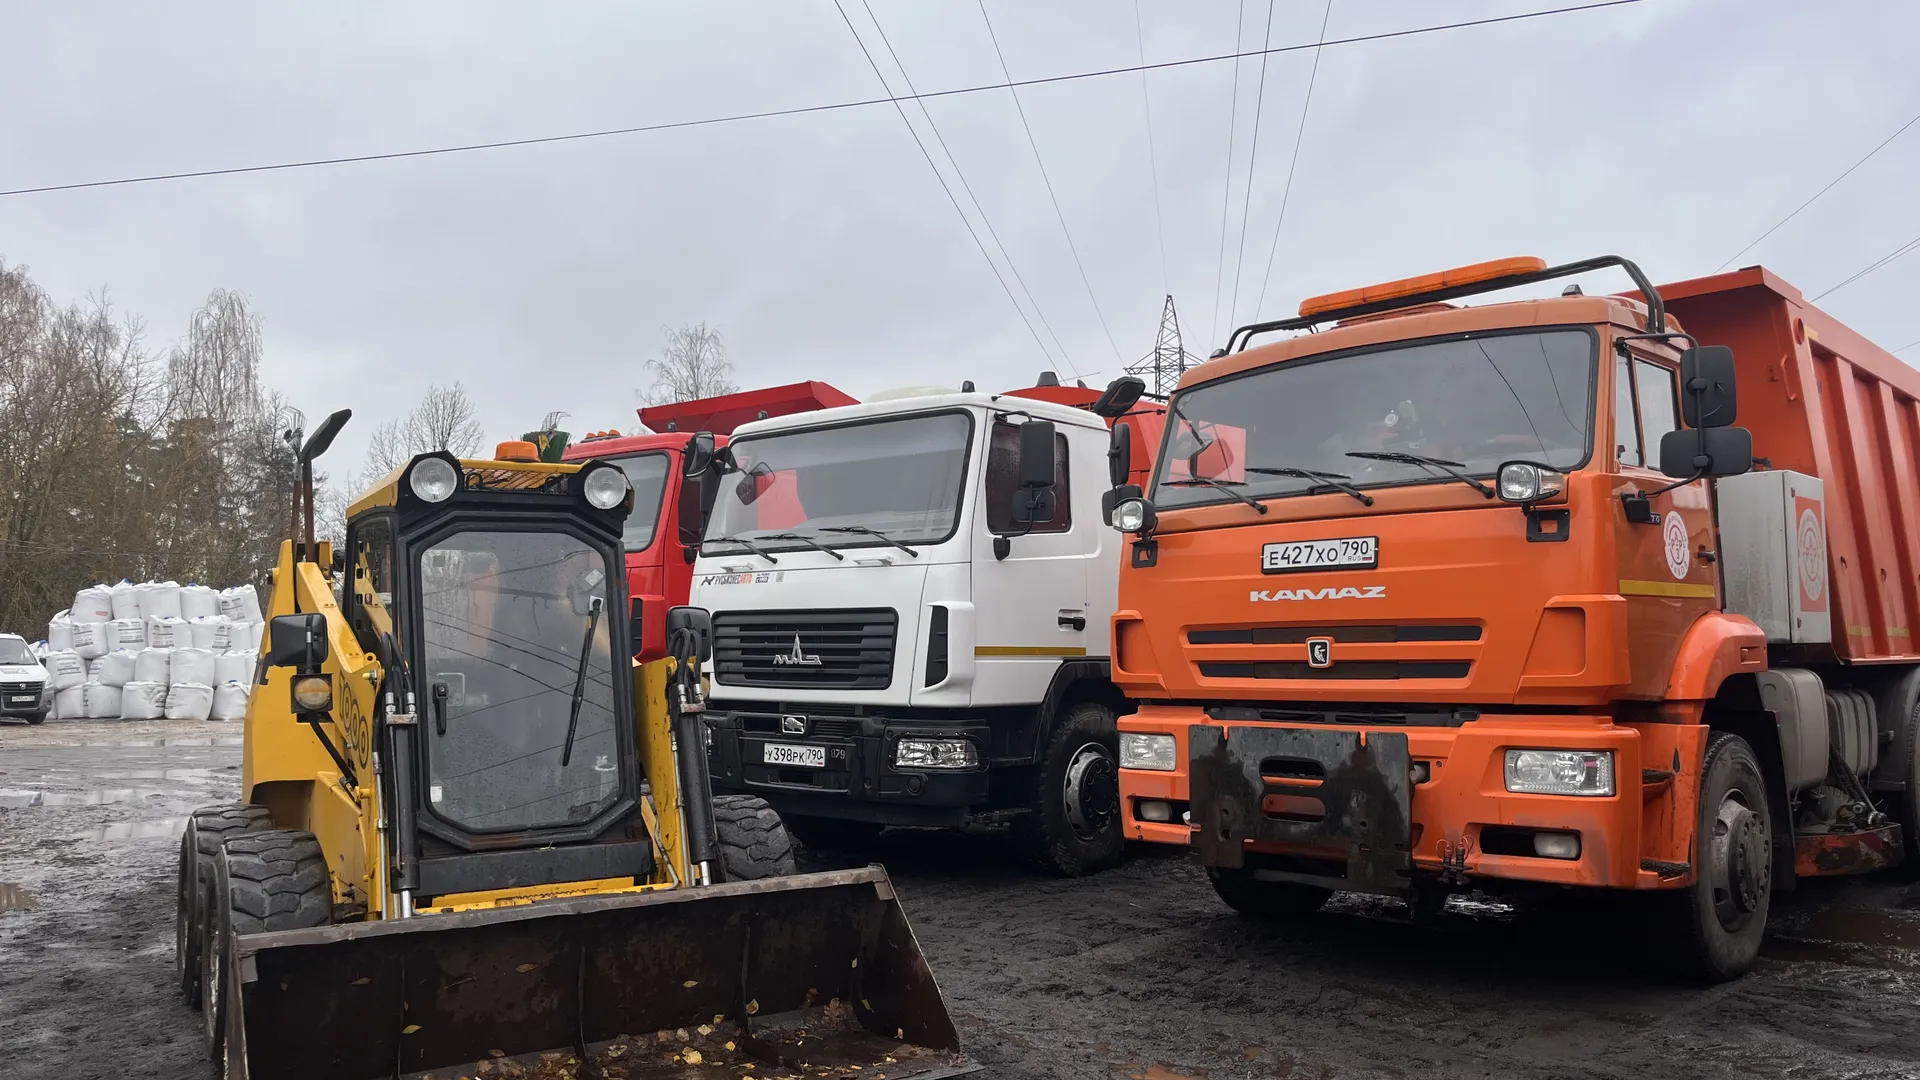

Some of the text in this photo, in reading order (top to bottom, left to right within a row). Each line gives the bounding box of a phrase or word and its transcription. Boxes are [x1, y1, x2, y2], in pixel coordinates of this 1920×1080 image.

[1342, 541, 1369, 556] 790
[1250, 586, 1386, 602] KAMAZ
[807, 749, 822, 760] 790
